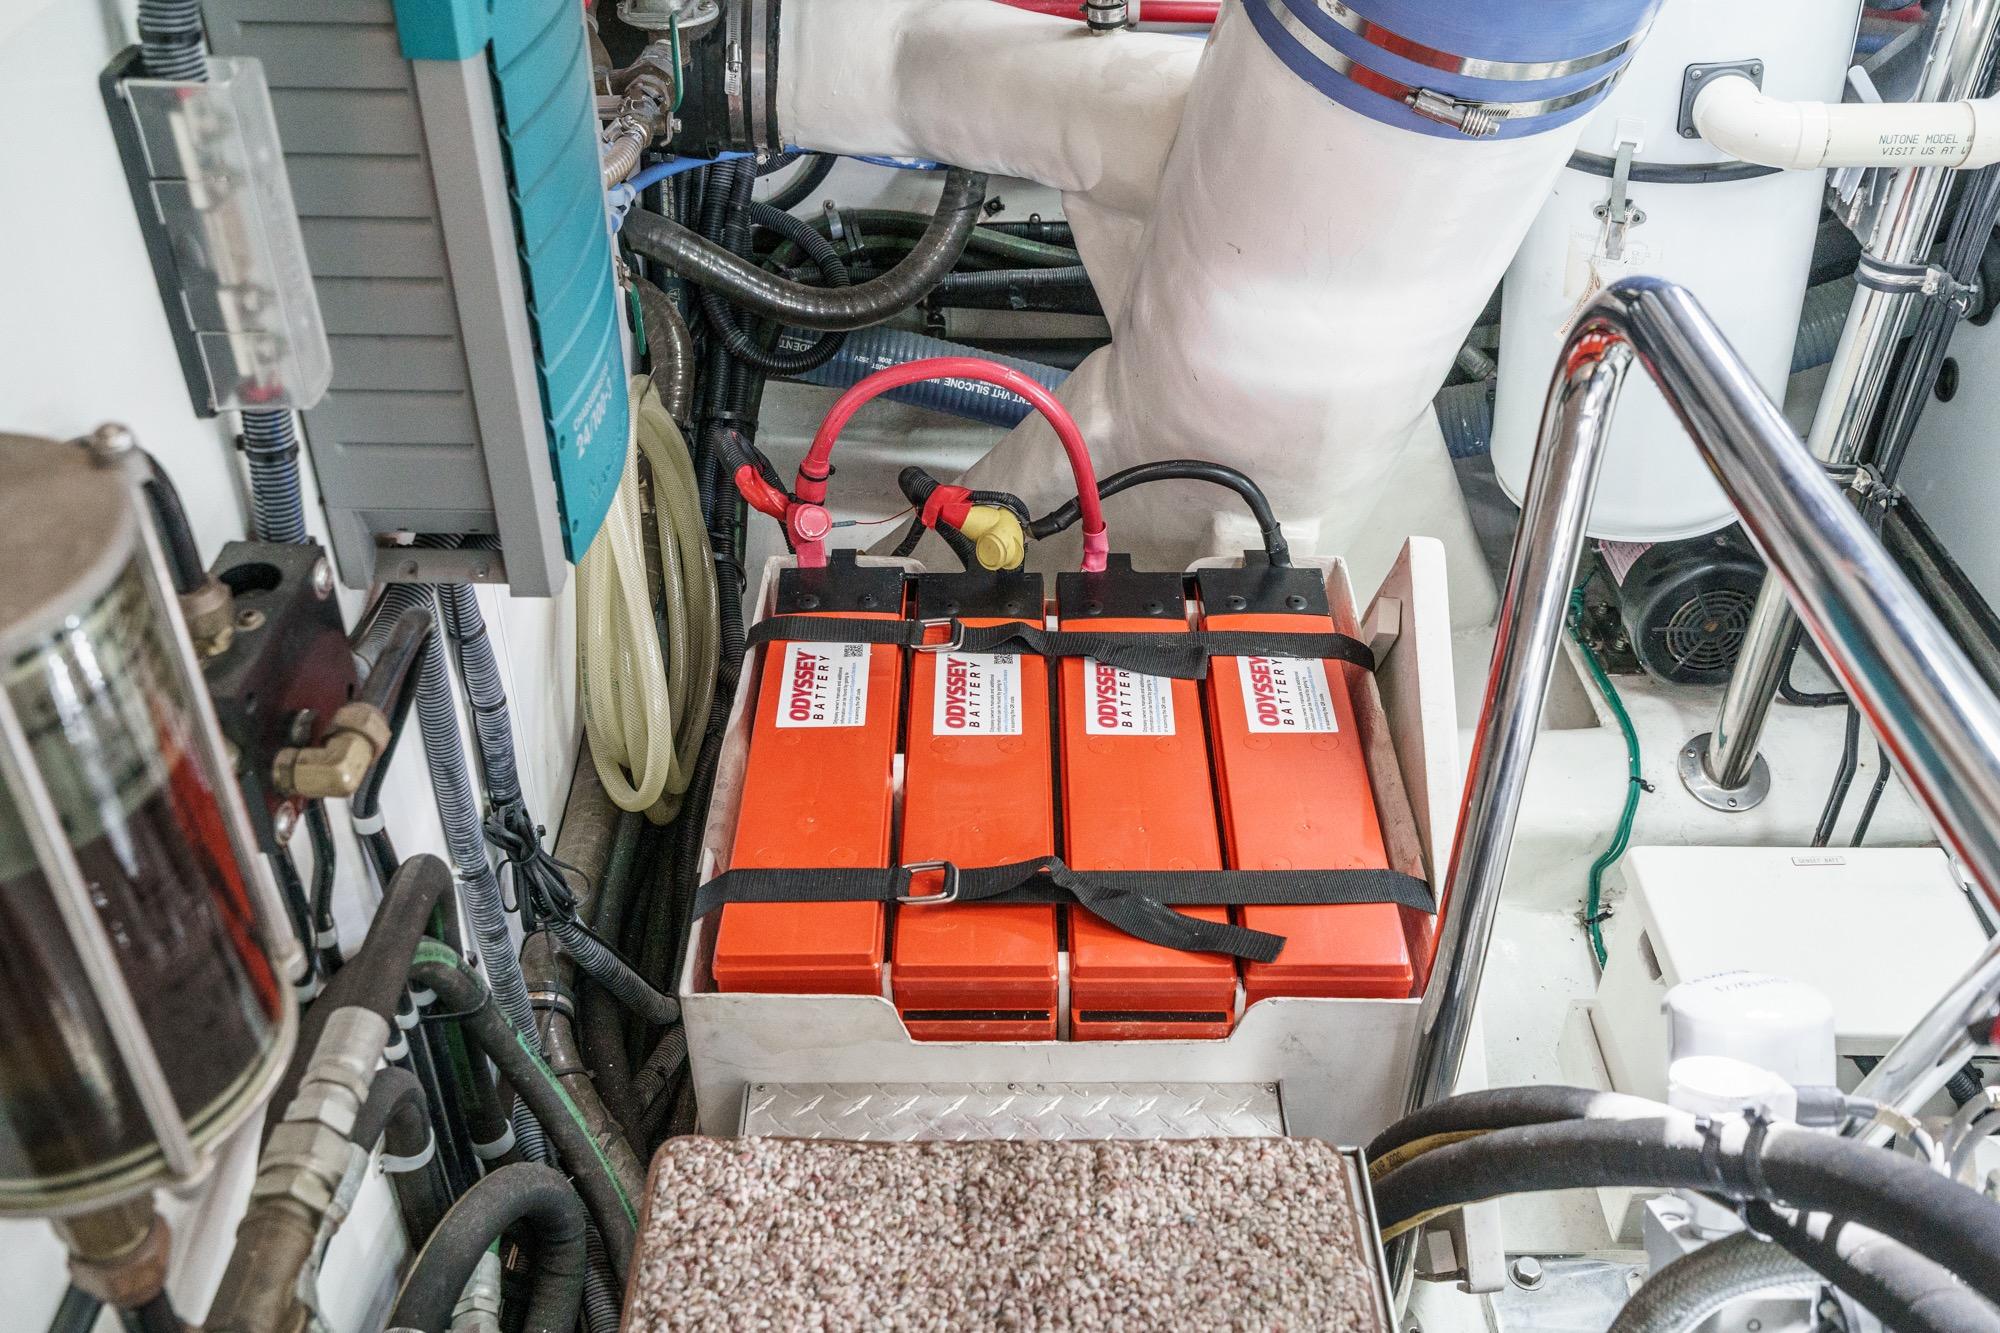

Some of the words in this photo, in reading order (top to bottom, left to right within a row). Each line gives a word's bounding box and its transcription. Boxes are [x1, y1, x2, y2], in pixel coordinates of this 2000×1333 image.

[1879, 135, 1919, 144] NUTONE
[1926, 135, 1958, 144] MODEL
[1882, 147, 1915, 155] VISIT
[944, 378, 990, 396] SILICONE
[789, 651, 817, 721] ODYSSEY
[813, 655, 830, 720] BATTERY
[945, 658, 968, 729] ODYSSEY
[969, 662, 980, 728] BATTERY
[1272, 659, 1294, 725] BATTERY
